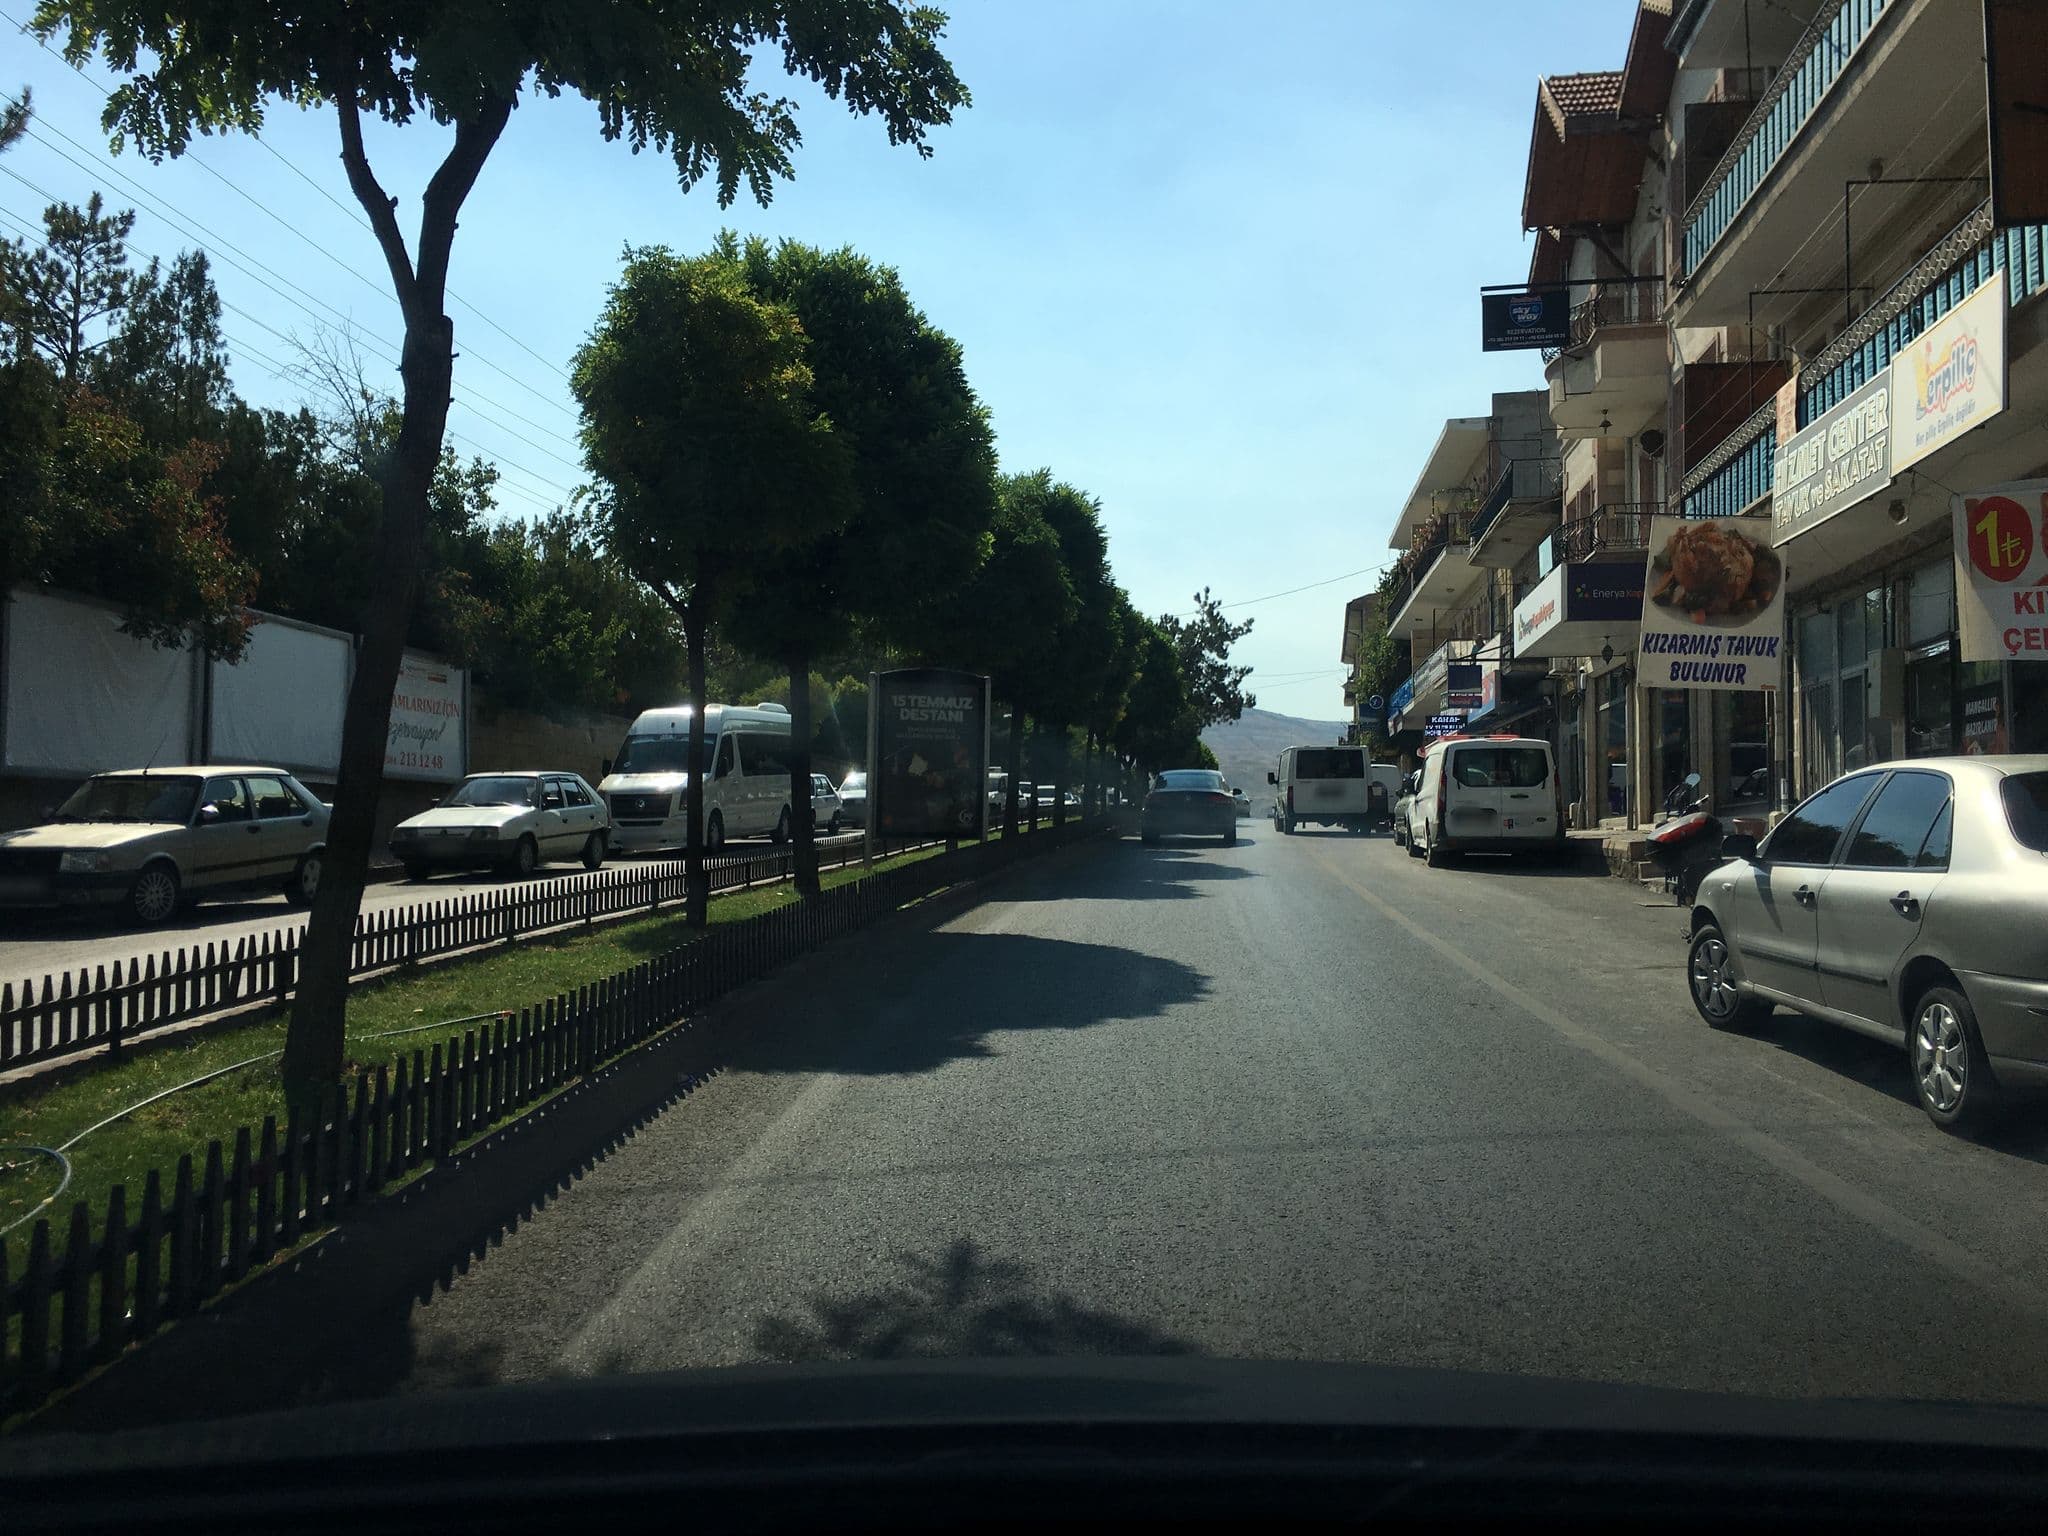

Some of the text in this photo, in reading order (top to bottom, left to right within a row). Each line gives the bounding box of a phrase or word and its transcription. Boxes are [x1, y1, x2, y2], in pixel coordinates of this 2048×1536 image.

[1774, 429, 1827, 498] HİZMET
[1828, 387, 1889, 462] CENTER
[1775, 435, 1887, 529] TAVUK ve SAKATAT
[1592, 588, 1625, 599] Enerya
[2013, 591, 2048, 615] KI
[1642, 632, 1780, 658] KIZARMIŞ TAVUK
[1669, 660, 1747, 685] BULUNUR
[900, 707, 964, 722] DESTANI
[908, 695, 974, 710] TEMMUZ
[400, 751, 417, 768] 213
[419, 755, 430, 768] 12
